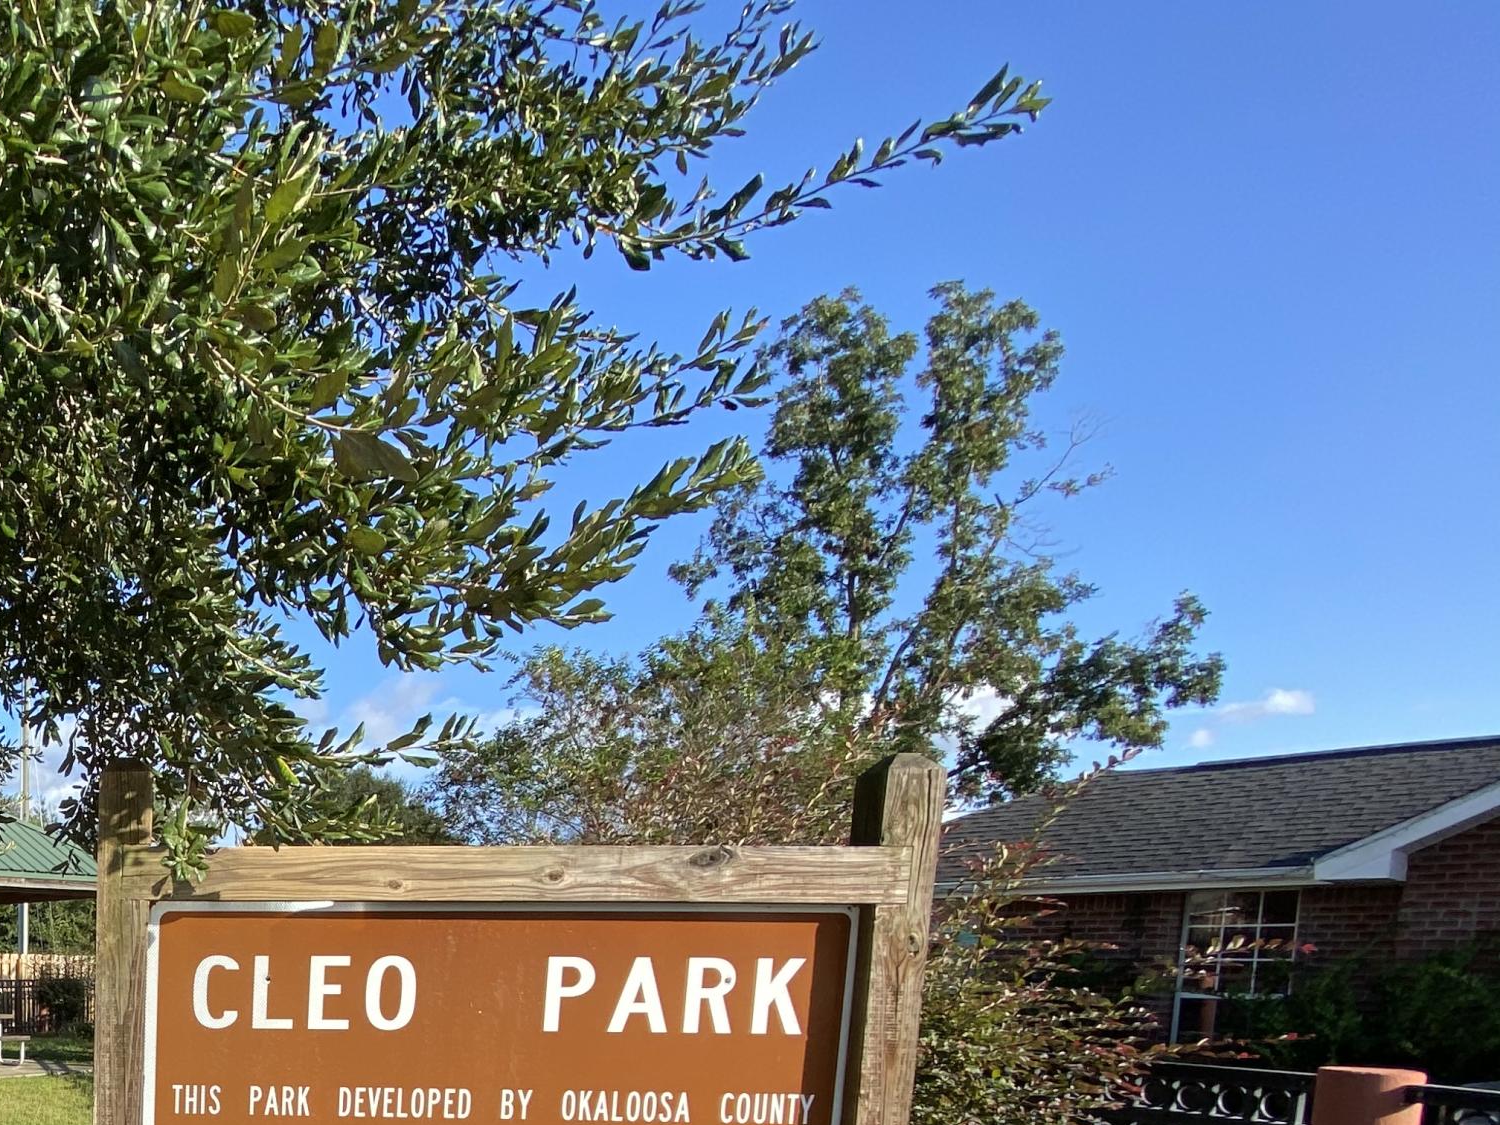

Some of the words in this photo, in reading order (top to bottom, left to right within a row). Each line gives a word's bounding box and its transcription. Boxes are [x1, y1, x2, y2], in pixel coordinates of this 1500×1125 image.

[192, 955, 417, 1031] CLEO
[542, 955, 807, 1036] PARK
[172, 1084, 221, 1115] THIS
[249, 1085, 309, 1116] PARK
[337, 1087, 472, 1119] DEVELOPED
[500, 1089, 533, 1120] BY
[560, 1090, 690, 1123] OKALOOSA
[719, 1092, 815, 1125] COUNTY
